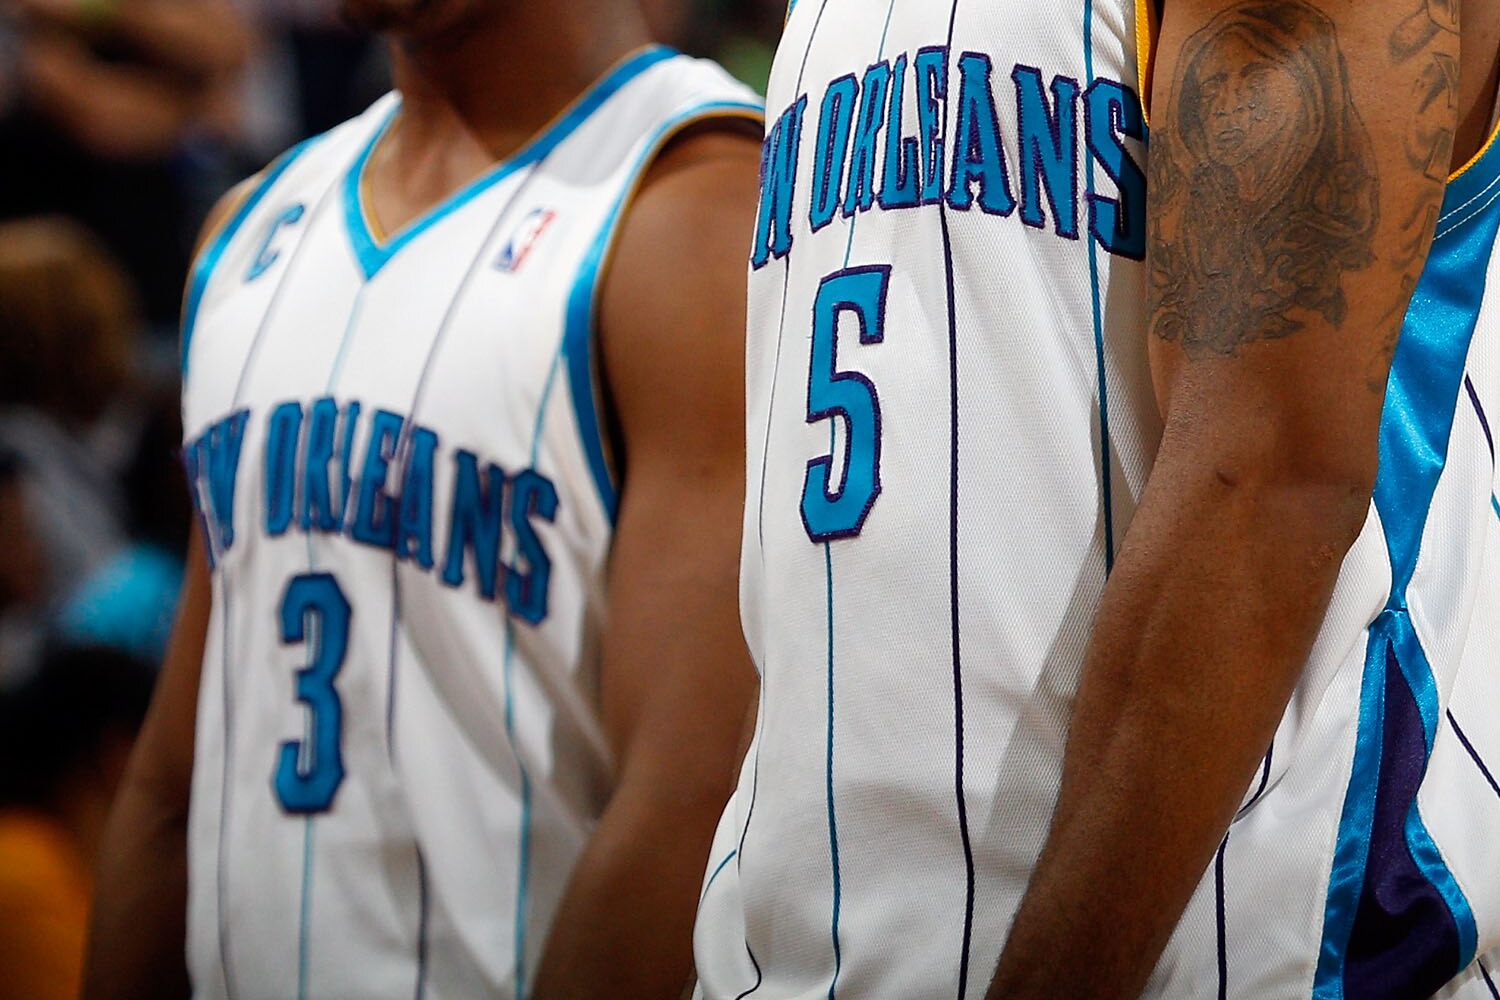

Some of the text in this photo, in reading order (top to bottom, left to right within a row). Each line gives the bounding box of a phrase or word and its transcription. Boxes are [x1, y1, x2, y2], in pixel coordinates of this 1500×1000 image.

[808, 44, 1147, 262] ORLEANS
[262, 396, 560, 629] ORLEANS
[799, 264, 893, 545] 5
[270, 572, 352, 815] 3
